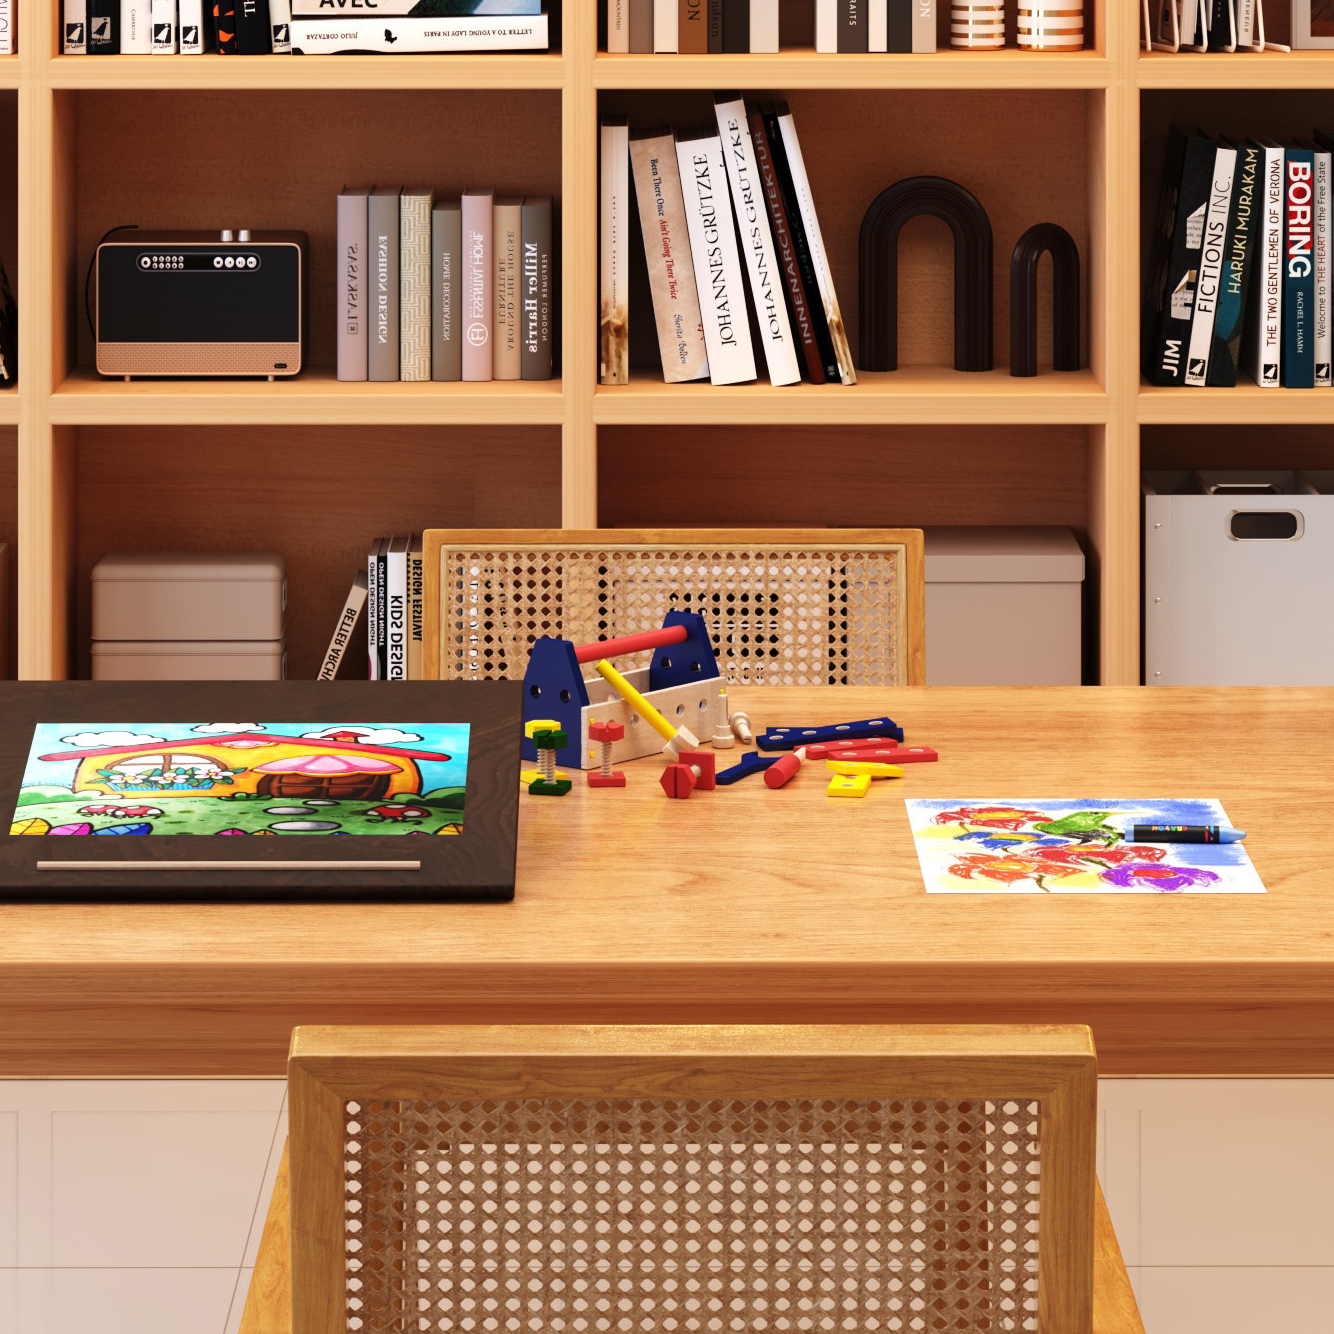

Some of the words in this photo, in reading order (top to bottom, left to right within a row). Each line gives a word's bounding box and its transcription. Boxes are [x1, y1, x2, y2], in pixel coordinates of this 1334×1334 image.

[693, 154, 719, 244] GRÜTZKE
[1288, 161, 1311, 278] BORING
[707, 247, 737, 346] JOHANNES
[1198, 222, 1224, 313] FICTIONS
[1162, 339, 1182, 377] JIM
